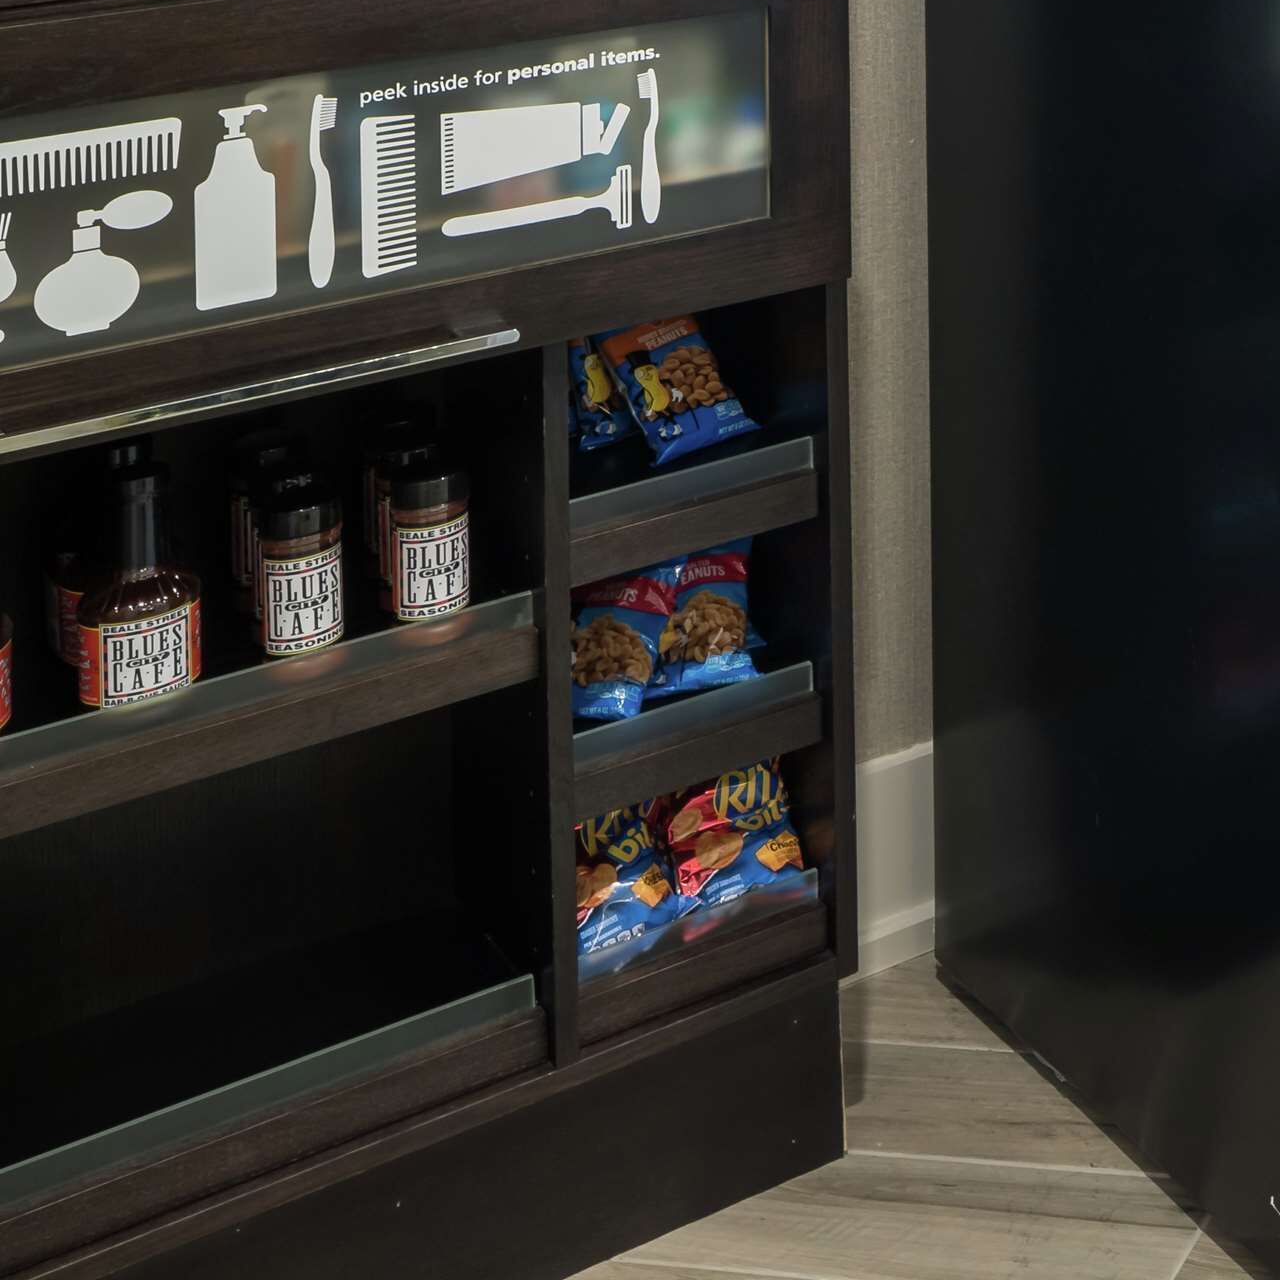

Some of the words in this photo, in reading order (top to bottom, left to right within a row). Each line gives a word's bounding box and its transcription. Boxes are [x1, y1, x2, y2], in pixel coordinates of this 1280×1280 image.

[360, 83, 407, 108] peek
[413, 72, 469, 96] inside
[474, 70, 503, 87] for
[507, 53, 594, 84] personal
[601, 48, 660, 67] items.
[400, 529, 435, 540] BEALE
[407, 533, 468, 570] BLUES
[265, 561, 299, 573] BEALE
[681, 564, 726, 584] EANUTS
[272, 565, 338, 603] BLUES
[401, 594, 469, 617] SEASONIN
[103, 622, 142, 635] BEALE
[147, 607, 188, 630] STREET
[112, 624, 182, 662] BLUES
